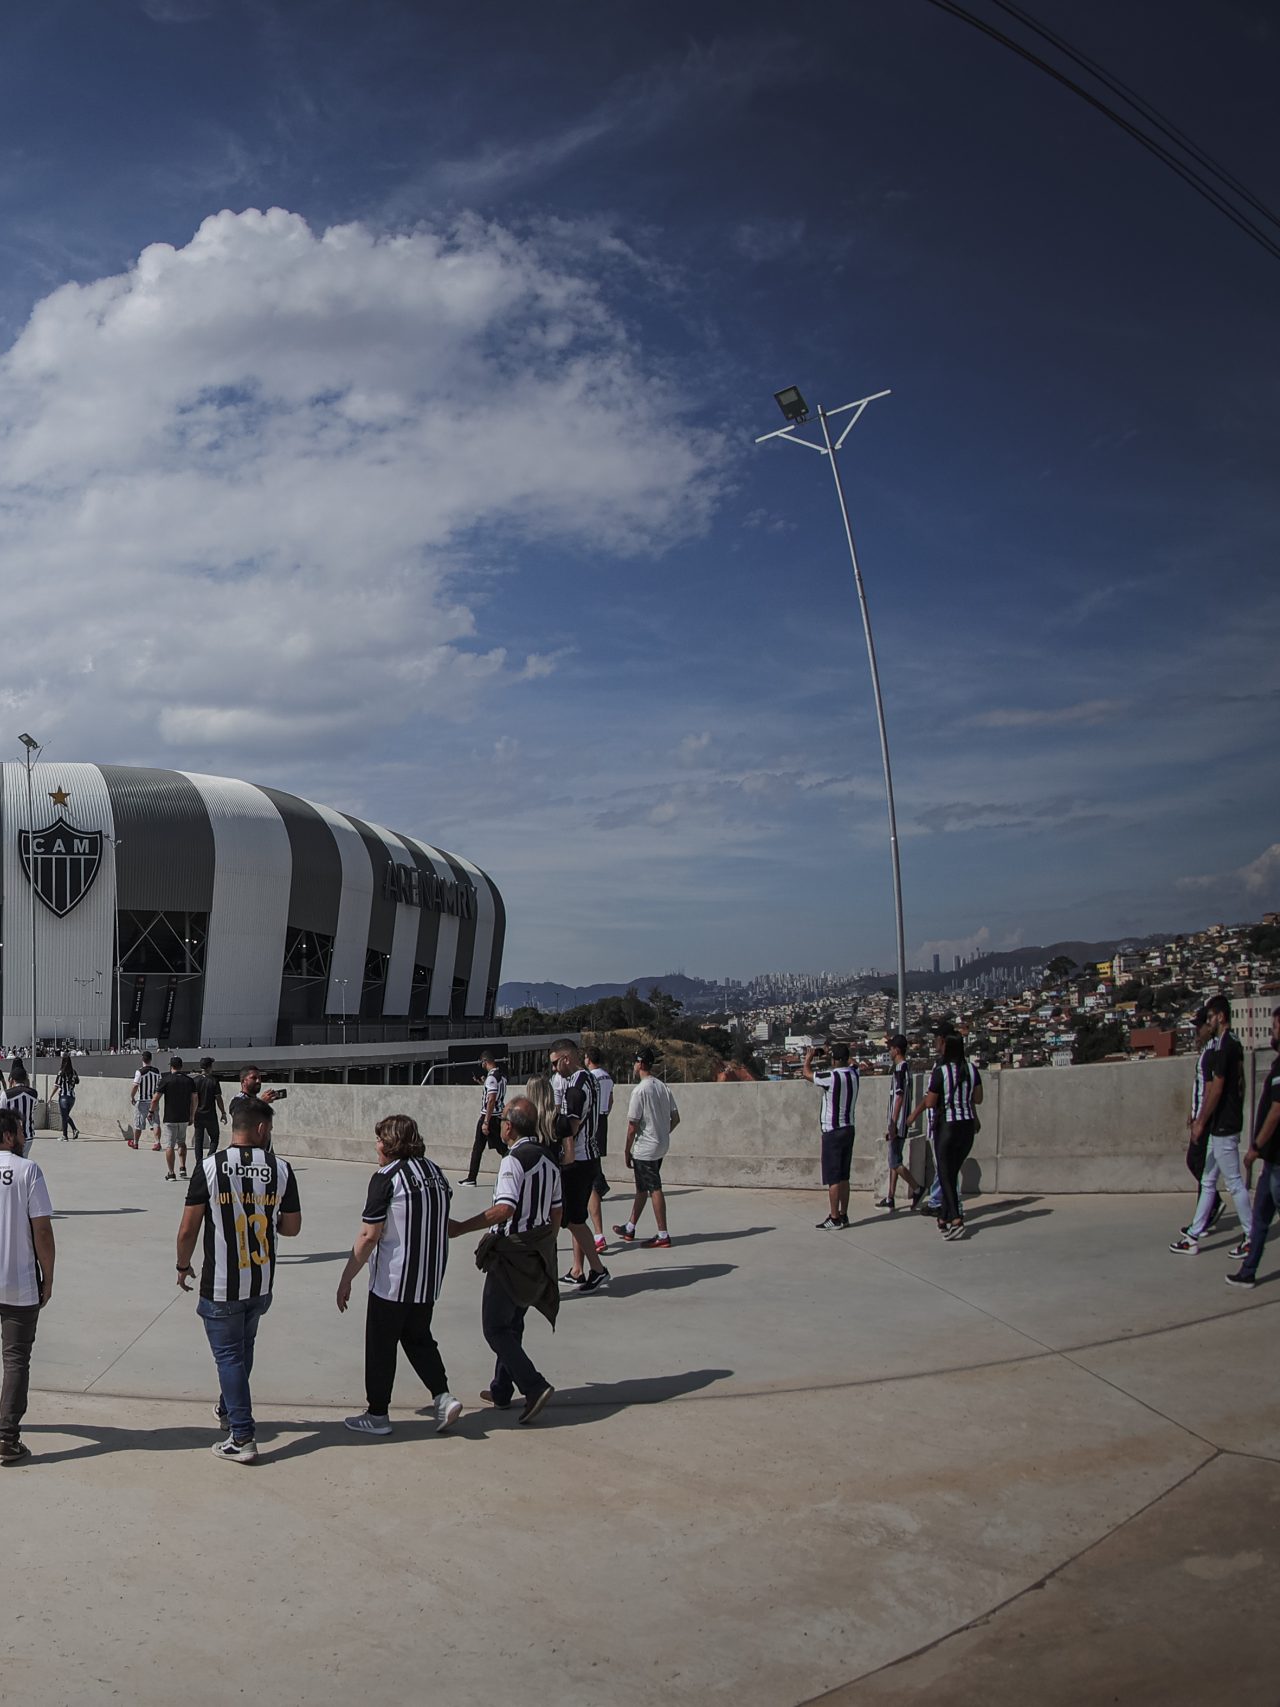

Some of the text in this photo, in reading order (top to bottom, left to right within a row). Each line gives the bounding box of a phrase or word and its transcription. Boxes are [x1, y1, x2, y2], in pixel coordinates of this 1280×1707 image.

[33, 838, 90, 853] CAM
[235, 1162, 271, 1183] bmg
[235, 1213, 271, 1269] 13
